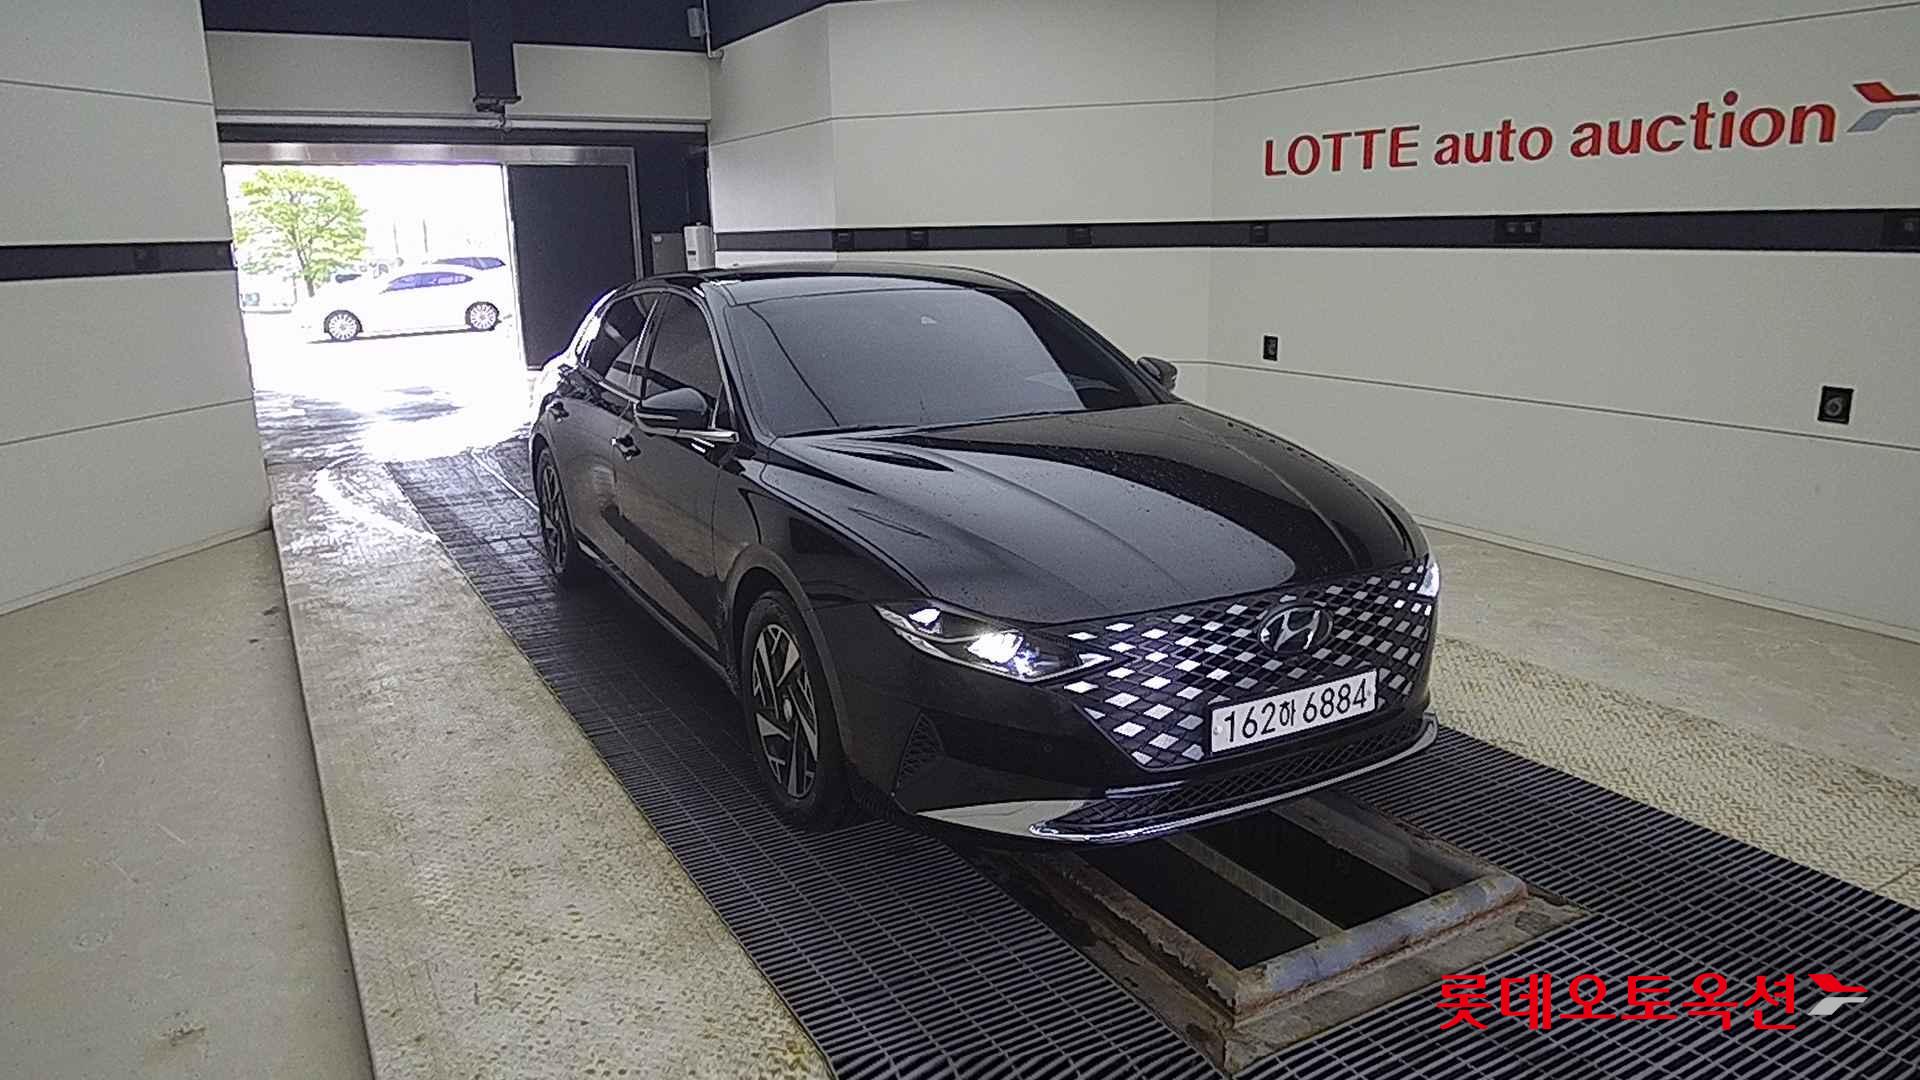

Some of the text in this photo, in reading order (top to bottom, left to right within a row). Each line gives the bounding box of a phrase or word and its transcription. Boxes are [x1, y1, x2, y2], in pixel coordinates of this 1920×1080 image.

[1264, 91, 1836, 177] LOTTE auto auction
